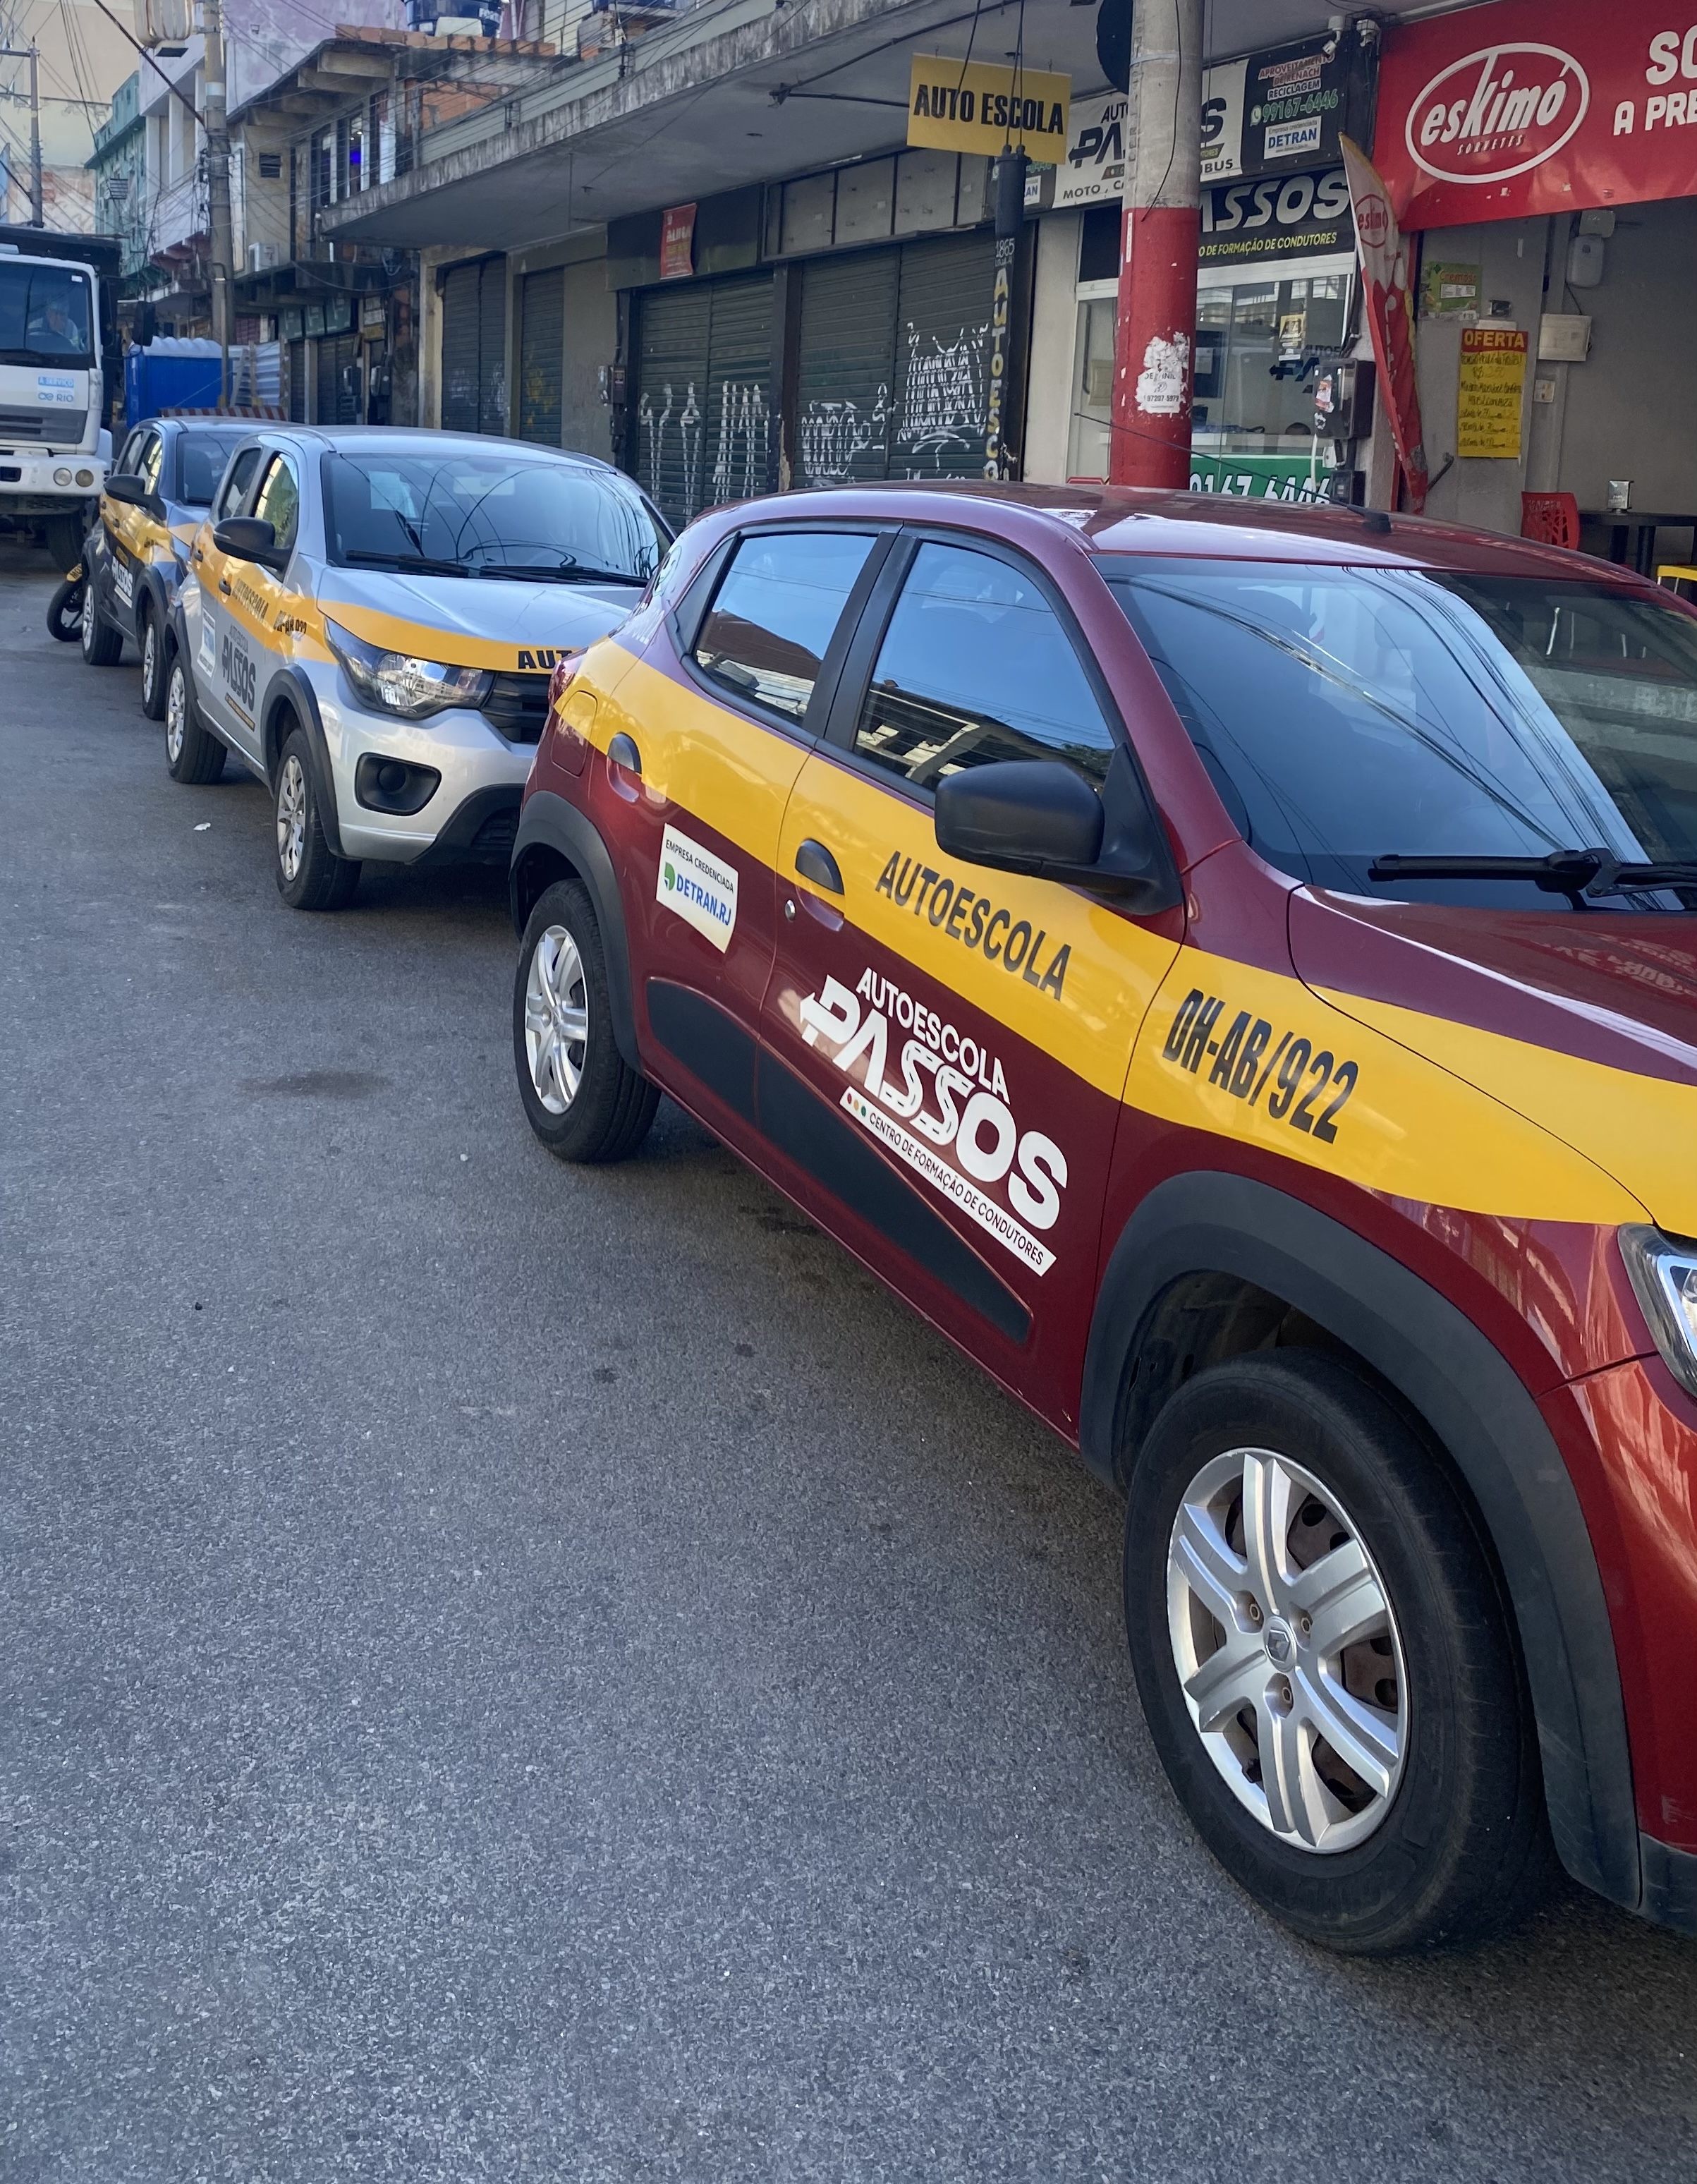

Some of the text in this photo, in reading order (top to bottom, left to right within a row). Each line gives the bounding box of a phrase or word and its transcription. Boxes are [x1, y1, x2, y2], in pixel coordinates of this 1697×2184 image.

[1268, 80, 1320, 99] RECICLAGEM
[1286, 67, 1320, 82] RENACH
[913, 84, 1064, 135] AUTO ESCOLA
[1263, 89, 1339, 123] 99167-6446
[1613, 100, 1635, 136] A
[1268, 128, 1317, 149] DETRAN
[1063, 184, 1100, 199] MOTO
[995, 238, 1014, 257] 1865
[1205, 246, 1217, 255] DE
[1217, 238, 1263, 256] FORMAÇÃO
[1265, 240, 1276, 249] DE
[1277, 232, 1337, 249] CONDUTORES
[1464, 330, 1525, 348] OFERTA
[56, 394, 74, 403] RIO
[666, 839, 734, 894] EMPRESA CREDENCIADA
[676, 873, 732, 926] DETRAN.RJ
[875, 850, 1071, 1002] AUTOESCOLA
[856, 966, 1010, 1105] AUTOESCOLA
[799, 973, 1068, 1230] PASSOS
[869, 1112, 1045, 1266] CENTRO DE FORMAÇÃO DE CONDUTORES
